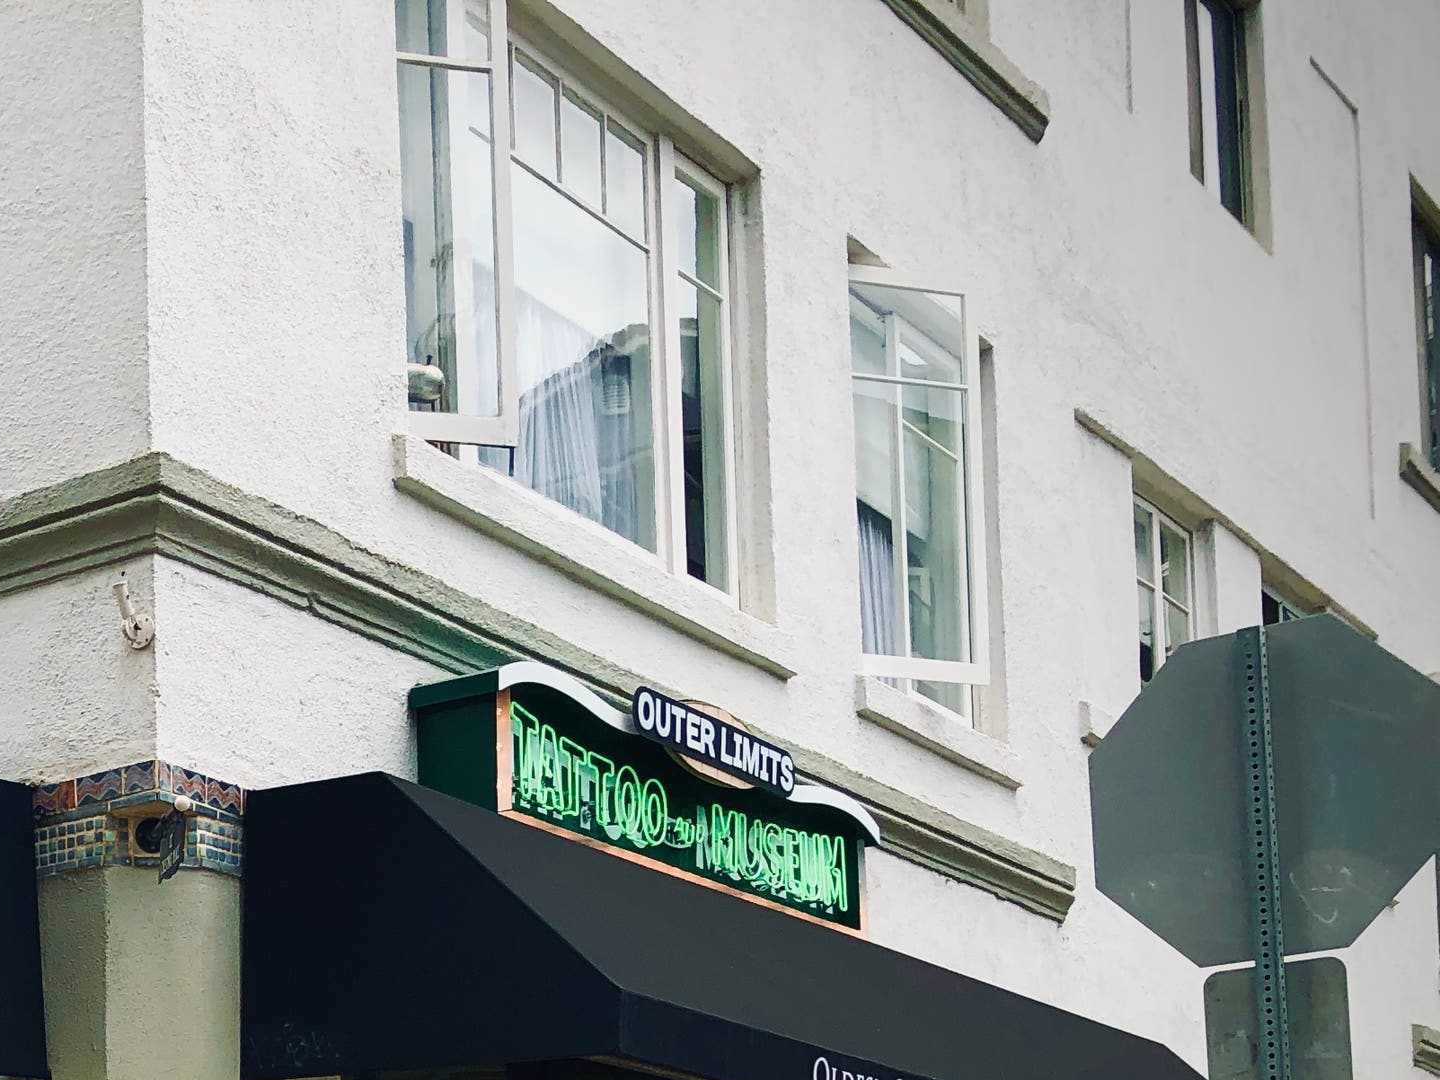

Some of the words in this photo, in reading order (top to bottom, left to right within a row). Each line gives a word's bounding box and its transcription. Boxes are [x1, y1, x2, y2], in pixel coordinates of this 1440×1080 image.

[510, 701, 668, 847] TATTOO
[708, 803, 848, 912] MUSEUM
[638, 691, 716, 759] OUTER
[720, 725, 795, 792] LIMITS
